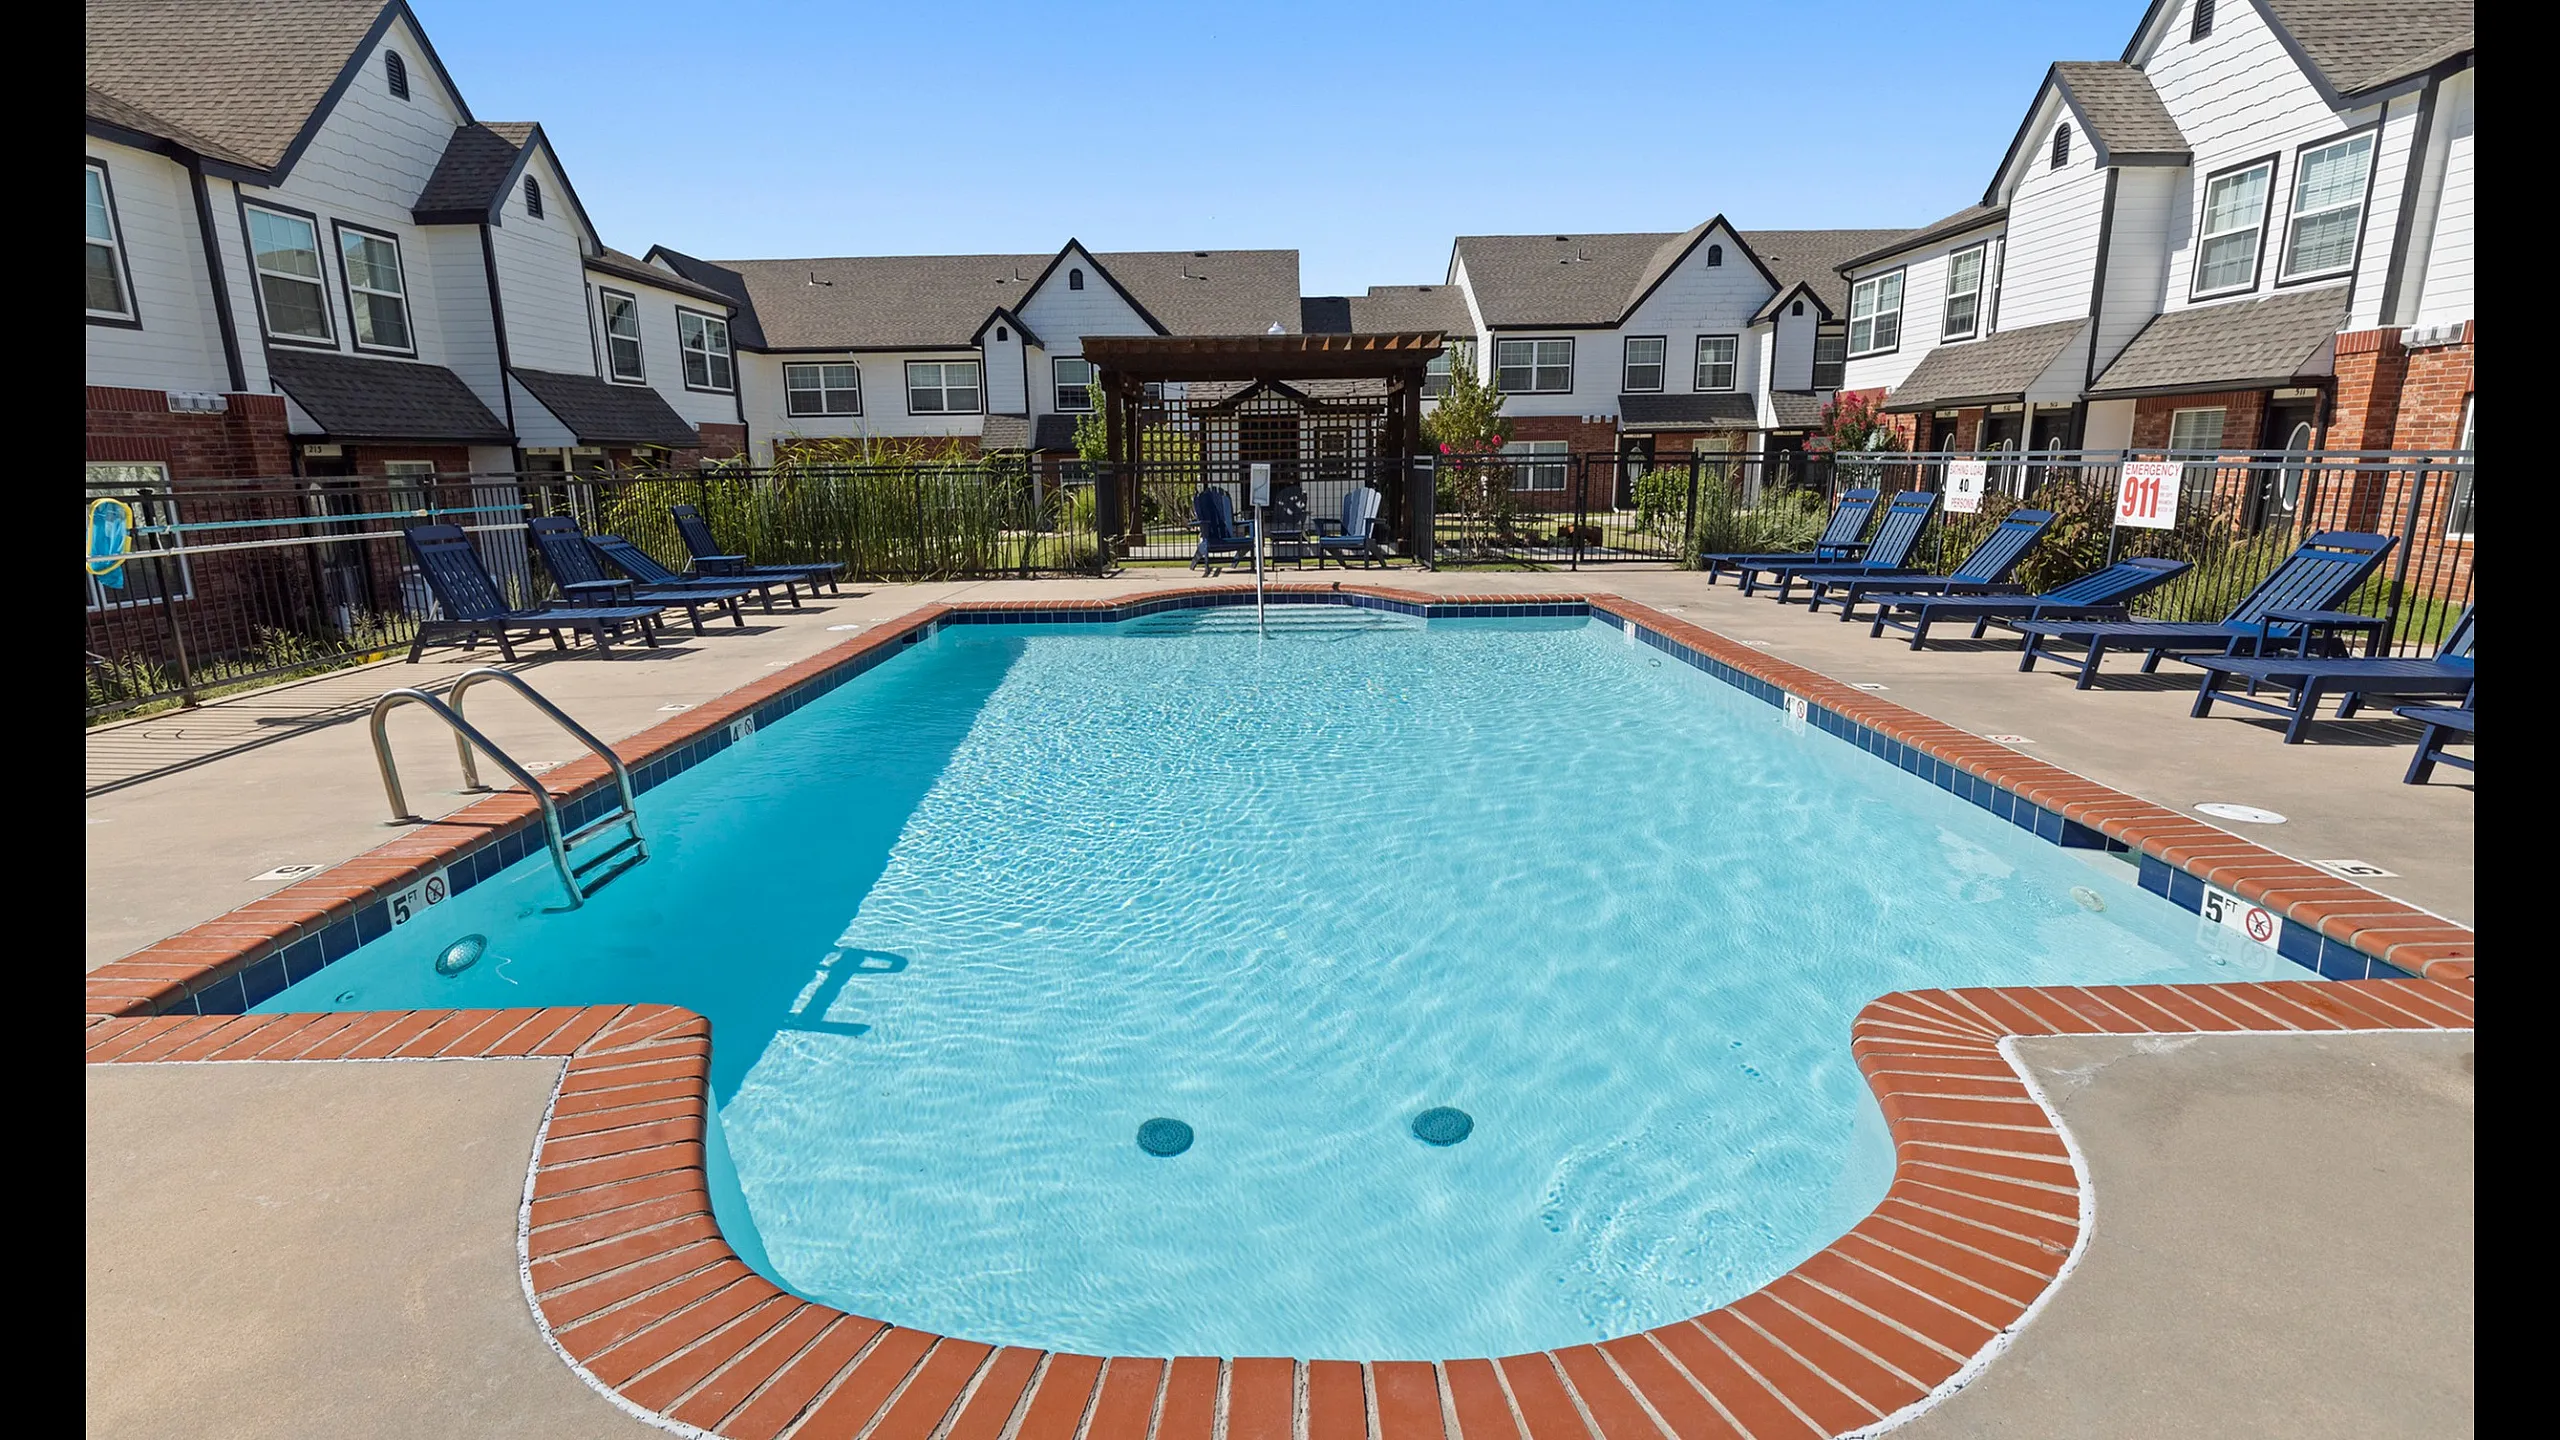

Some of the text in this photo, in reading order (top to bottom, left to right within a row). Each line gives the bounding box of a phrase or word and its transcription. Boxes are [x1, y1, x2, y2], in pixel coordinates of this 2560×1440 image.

[1970, 465, 1984, 476] LOAD
[2125, 463, 2182, 477] EMERGENCY
[1959, 478, 1970, 493] 40
[2121, 476, 2161, 519] 911
[1785, 696, 1791, 714] 4
[732, 725, 740, 742] 4
[393, 888, 418, 926] 5 FT
[2205, 890, 2239, 924] 5 FT
